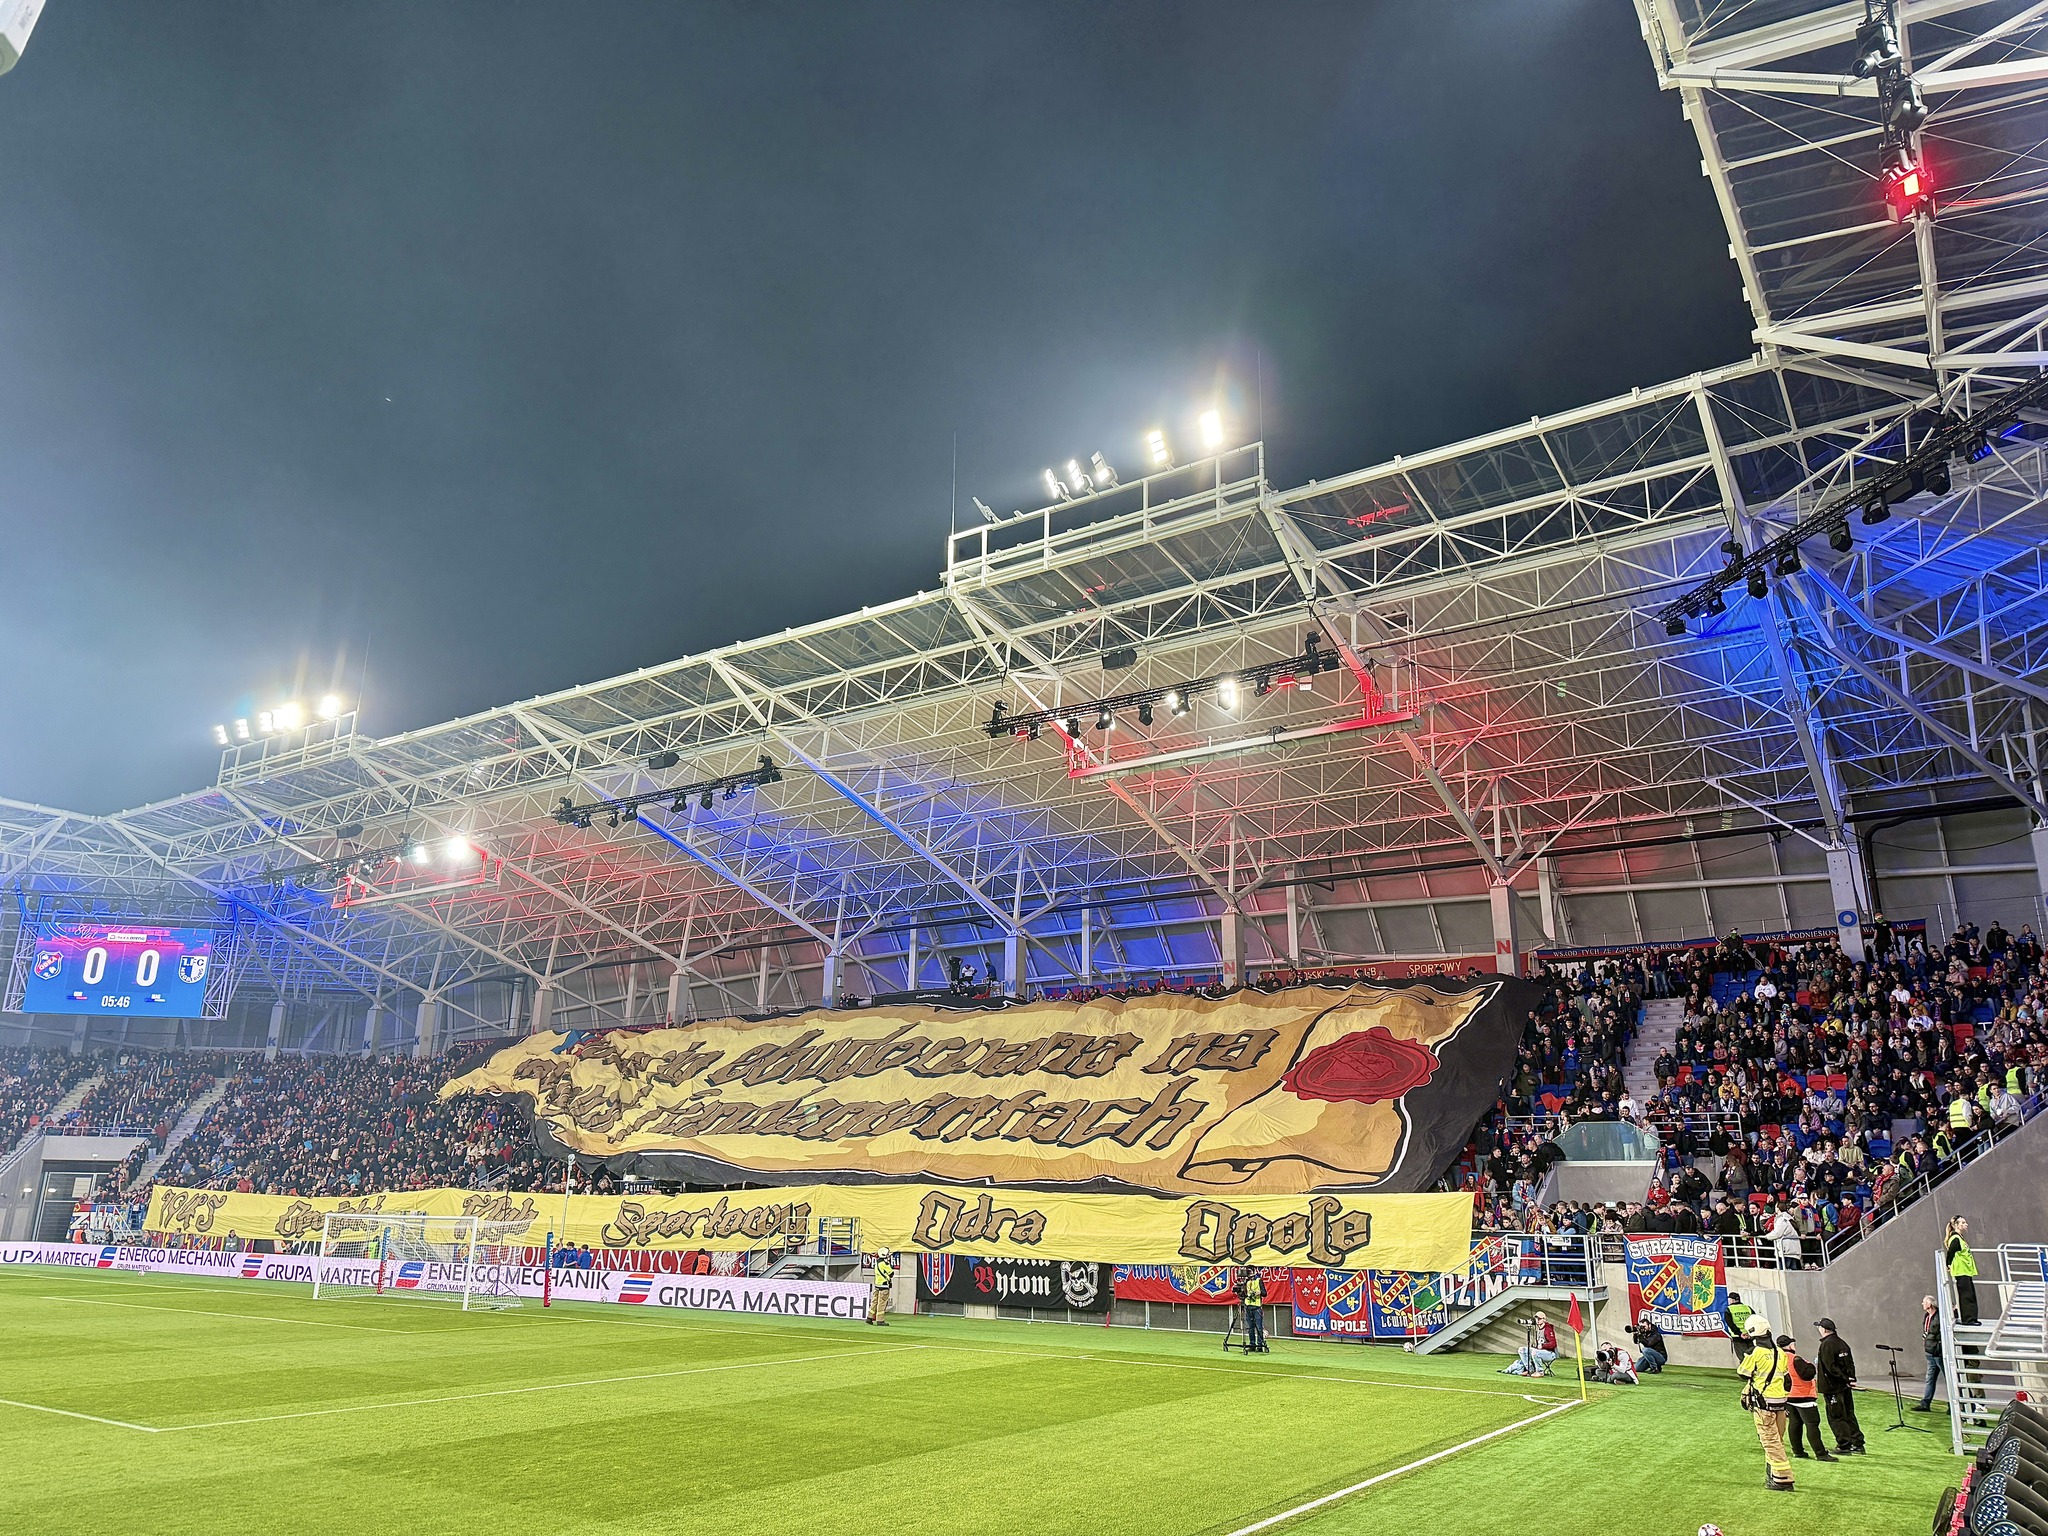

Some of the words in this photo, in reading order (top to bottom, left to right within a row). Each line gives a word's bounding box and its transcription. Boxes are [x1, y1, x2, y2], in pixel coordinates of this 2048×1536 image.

[1498, 940, 1511, 954] N
[1650, 942, 1684, 950] KRKIEM
[1789, 929, 1837, 939] PODNIESION
[83, 947, 107, 985] 0
[136, 949, 160, 987] 0
[1224, 962, 1235, 975] N
[1353, 967, 1377, 977] KUB
[101, 995, 131, 1008] 05:46
[267, 1037, 277, 1047] K
[363, 1040, 371, 1049] K
[414, 1035, 421, 1046] K
[1140, 1028, 1281, 1074] na
[601, 1196, 812, 1247] Sportowy
[912, 1190, 1047, 1250] Odra
[1178, 1195, 1371, 1267] Opole
[0, 1250, 42, 1263] UPA
[45, 1250, 97, 1267] MARTECH
[119, 1247, 165, 1263] ENERGO
[168, 1249, 237, 1268] MECHANIK
[1627, 1238, 1718, 1261] STRZELCE
[588, 1249, 688, 1275] ANATYCY
[265, 1263, 313, 1282] GRUPA
[320, 1267, 394, 1287] MARTECH
[505, 1266, 611, 1290] MECHANIK
[974, 1266, 1051, 1302] Bytom
[1328, 1273, 1343, 1282] OKS
[1646, 1265, 1677, 1298] ODRA
[449, 1284, 480, 1293] MARTCH
[1329, 1278, 1362, 1303] ODRA
[1385, 1277, 1409, 1301] ODRA
[658, 1286, 736, 1310] GRUPA
[743, 1291, 867, 1319] MARTECH
[1295, 1316, 1327, 1331] ODRA
[1330, 1319, 1368, 1332] OPOLE
